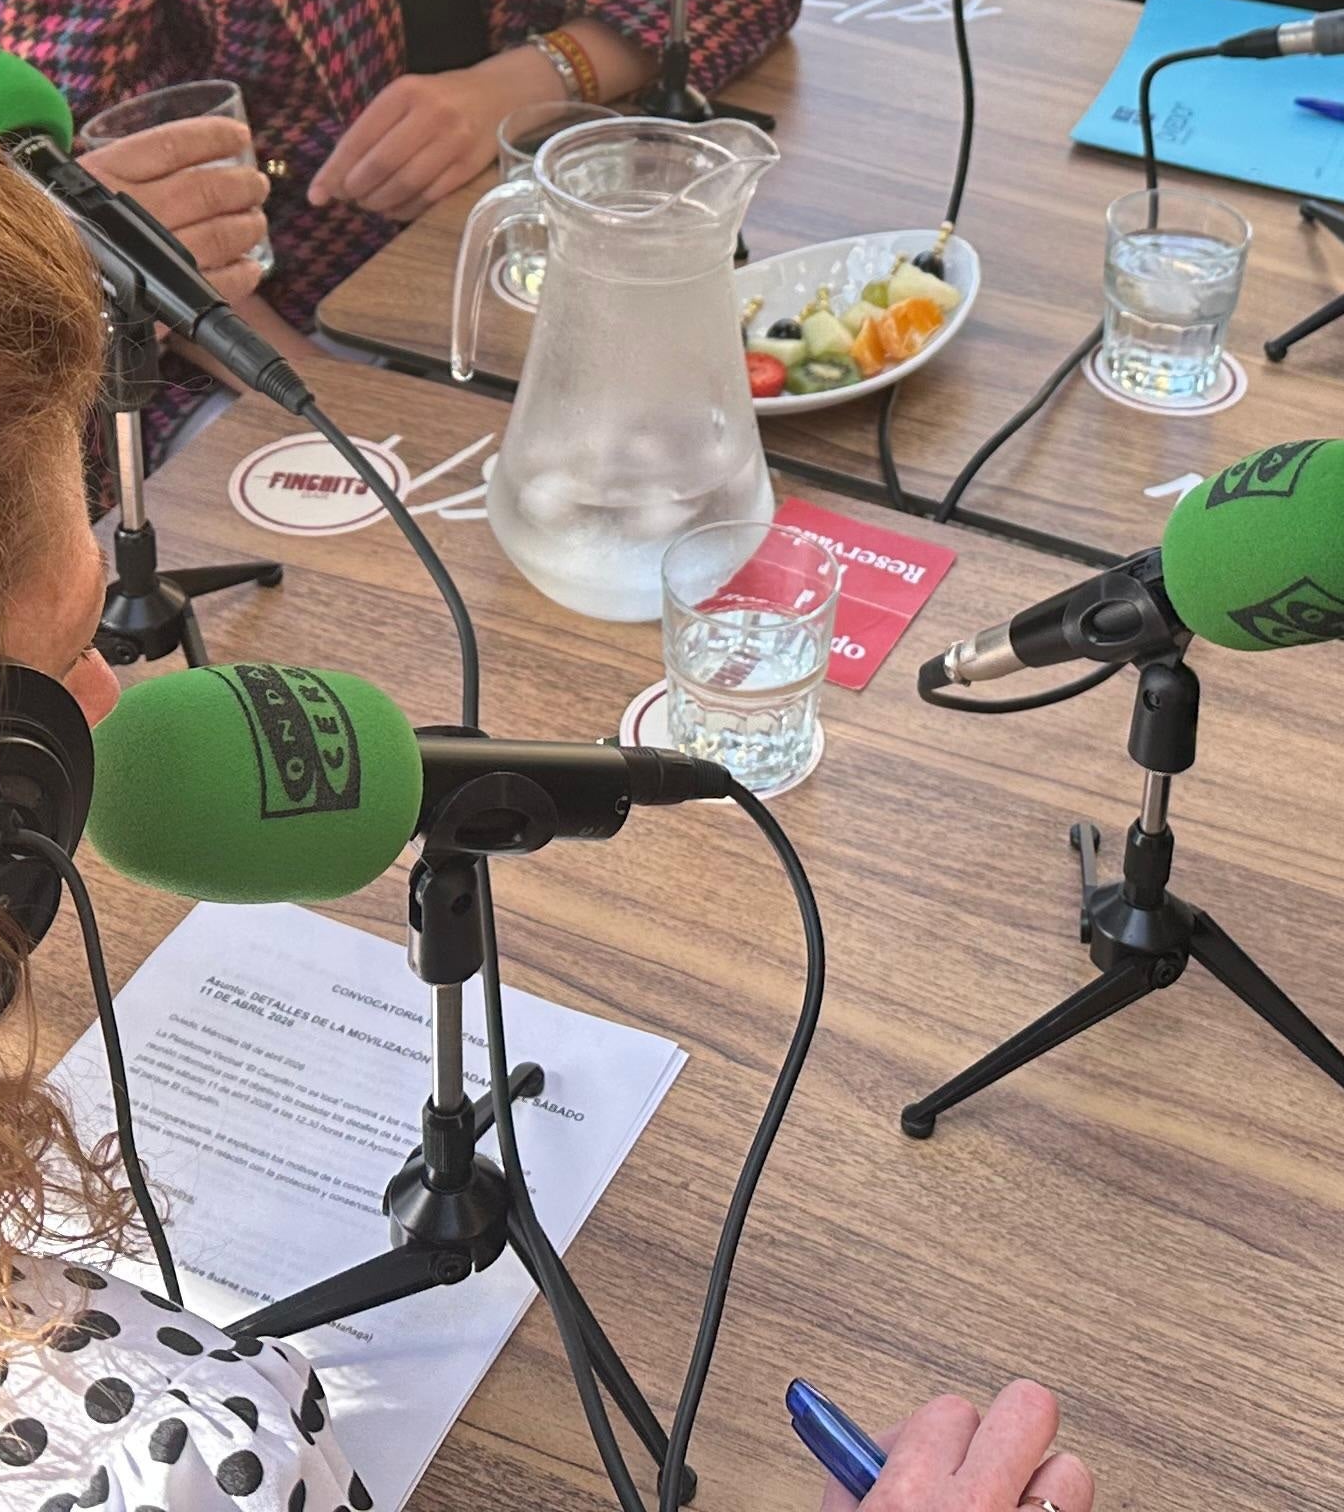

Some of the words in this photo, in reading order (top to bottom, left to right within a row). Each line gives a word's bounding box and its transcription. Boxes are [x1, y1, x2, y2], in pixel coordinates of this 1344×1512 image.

[246, 667, 306, 782] ONDA
[280, 667, 345, 770] CERO
[199, 985, 212, 995] 11
[214, 991, 229, 1001] DE
[232, 998, 265, 1015] ABRIL
[267, 1011, 294, 1026] 2026
[206, 976, 248, 996] Asunto:
[250, 992, 309, 1019] DETALLES
[311, 1015, 327, 1025] DE
[330, 1022, 344, 1032] LA
[348, 1026, 431, 1064] MOVILIZACIÓN
[532, 1096, 585, 1122] SÁBADO
[332, 983, 424, 1023] CONVOCATORIA
